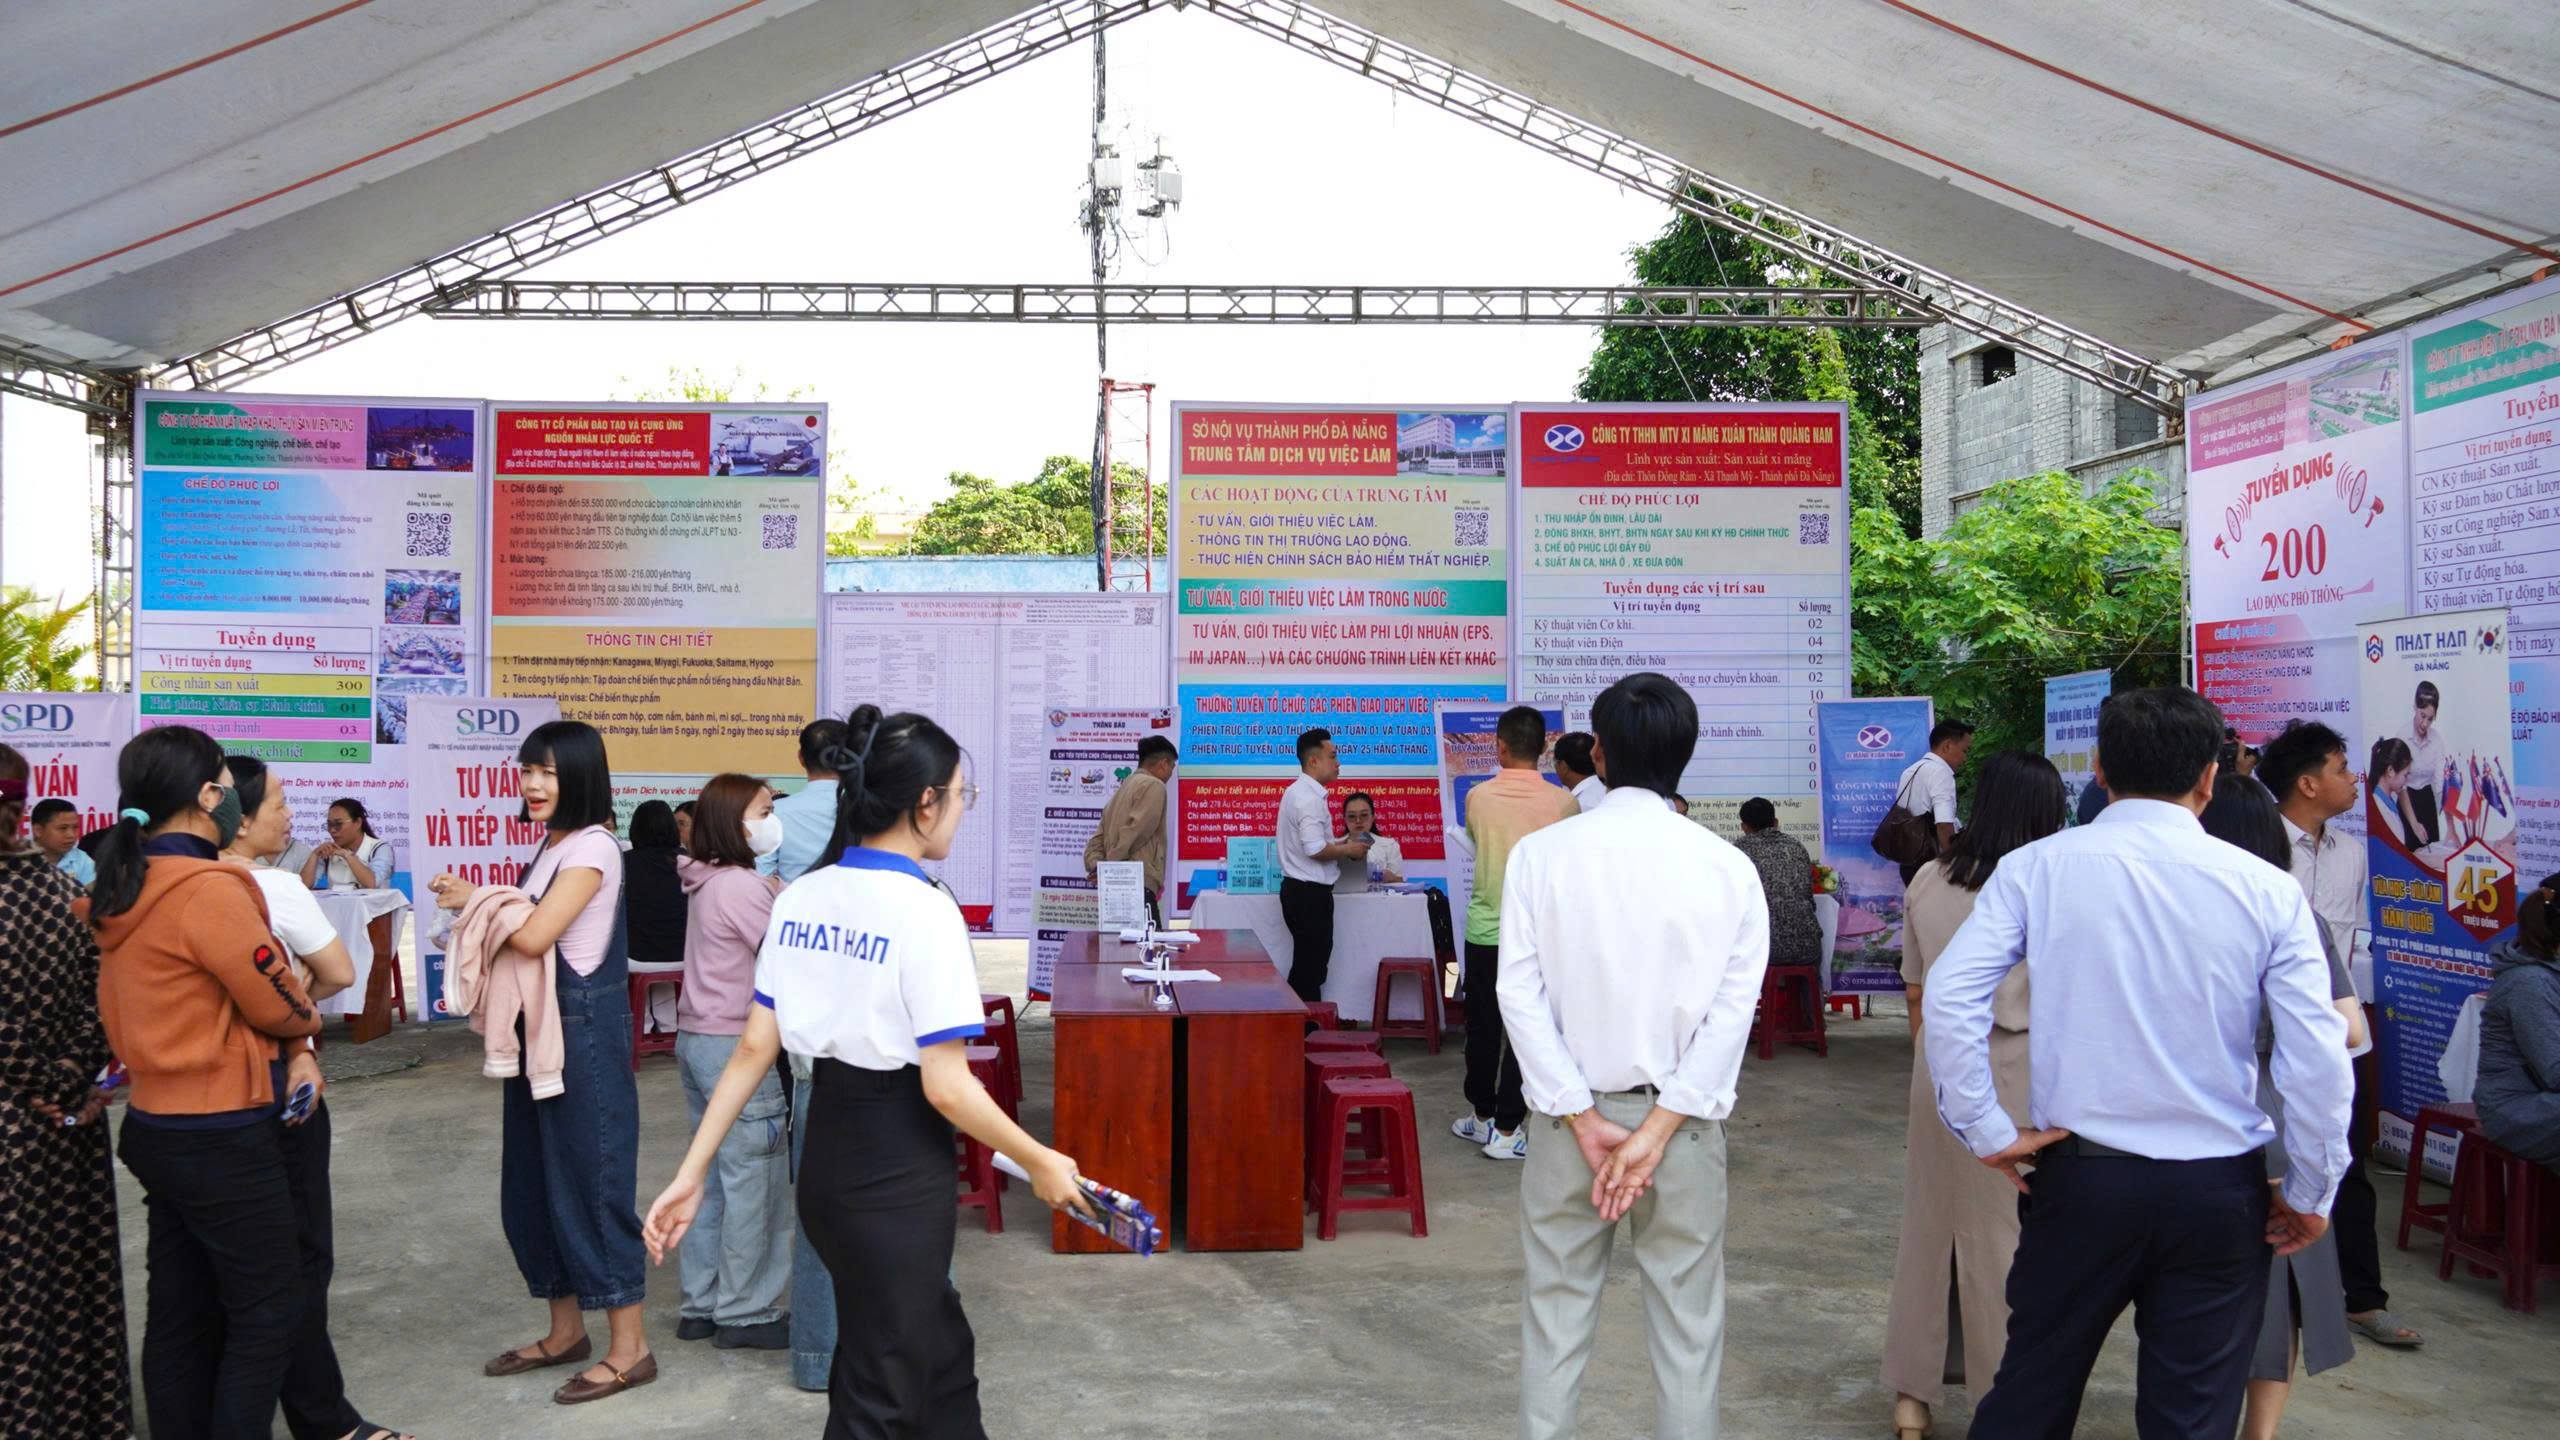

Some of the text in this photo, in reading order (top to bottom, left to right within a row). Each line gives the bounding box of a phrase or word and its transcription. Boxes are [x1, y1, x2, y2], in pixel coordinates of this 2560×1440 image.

[1192, 417, 1210, 437] SỞ
[1212, 419, 1231, 440] NỘI
[1235, 424, 1252, 440] VỤ
[1255, 420, 1298, 438] THÀNH
[1303, 417, 1328, 438] PHỐ
[1331, 420, 1348, 438] ĐÀ
[1189, 444, 1391, 466] TRUNG TÂM DỊCH VỤ VIỆC LÀM
[2246, 452, 2333, 504] TUYỂN DỤNG
[1190, 484, 1222, 501] CÁC
[1227, 488, 1269, 504] HOẠT
[1274, 486, 1318, 504] ĐỘNG
[1360, 488, 1409, 502] TRUNG
[1414, 483, 1447, 502] TÂM
[1198, 514, 1214, 527] TƯ
[1249, 513, 1274, 527] GIỚI
[1278, 513, 1313, 529] THIỆU
[1317, 512, 1345, 529] VIỆC
[1198, 532, 1240, 546] THÔNG
[1245, 535, 1263, 545] TIN
[1291, 532, 1341, 546] TRƯỜNG
[1346, 535, 1369, 546] LAO
[1198, 553, 1230, 567] THỰC
[1235, 551, 1263, 566] HIỆN
[1267, 551, 1304, 565] CHÍNH
[1309, 551, 1341, 565] SÁCH
[1346, 550, 1371, 565] BẢO
[1375, 549, 1405, 565] HIỂM
[1409, 549, 1440, 565] THẤT
[2261, 524, 2326, 581] 200
[1603, 579, 1765, 596] Tuyển dụng các vị trí sau
[1188, 589, 1203, 607] TƯ
[1240, 587, 1264, 607] GIỚI
[1268, 587, 1303, 609] THIỆU
[1308, 587, 1334, 609] VIỆC
[1339, 587, 1364, 607] LÀM
[1368, 590, 1409, 607] TRONG
[1414, 587, 1447, 608] NƯỚC
[1193, 622, 1209, 639] TƯ
[1244, 622, 1268, 639] GIỚI
[1272, 621, 1306, 641] THIỆU
[1311, 621, 1337, 641] VIỆC
[1342, 621, 1366, 639] LÀM
[1370, 624, 1390, 639] PHI
[1394, 623, 1413, 641] LỢI
[1417, 622, 1459, 641] NHUẬN
[1808, 618, 1822, 629] 02
[217, 628, 316, 650] Tuyển dụng
[586, 630, 712, 647] THÔNG TIN CHI TIẾT
[1808, 636, 1822, 647] 04
[1189, 650, 1203, 664] IM
[1269, 648, 1285, 665] VÀ
[1288, 648, 1312, 665] CÁC
[1316, 647, 1366, 665] CHƯƠNG
[1370, 647, 1405, 664] TRÌNH
[1410, 647, 1436, 664] LIÊN
[1440, 646, 1461, 664] KẾT
[1465, 647, 1498, 665] KHÁC
[1808, 654, 1822, 665] 02
[336, 681, 363, 691] 300
[1808, 672, 1822, 683] 02
[0, 704, 74, 732] SPD
[456, 709, 520, 736] SPD
[340, 726, 357, 735] 03
[340, 748, 357, 757] 02
[34, 753, 78, 796] VẤN
[457, 764, 482, 798] TƯ
[426, 805, 498, 846] VÀ TIẾP
[2455, 866, 2498, 913] 45
